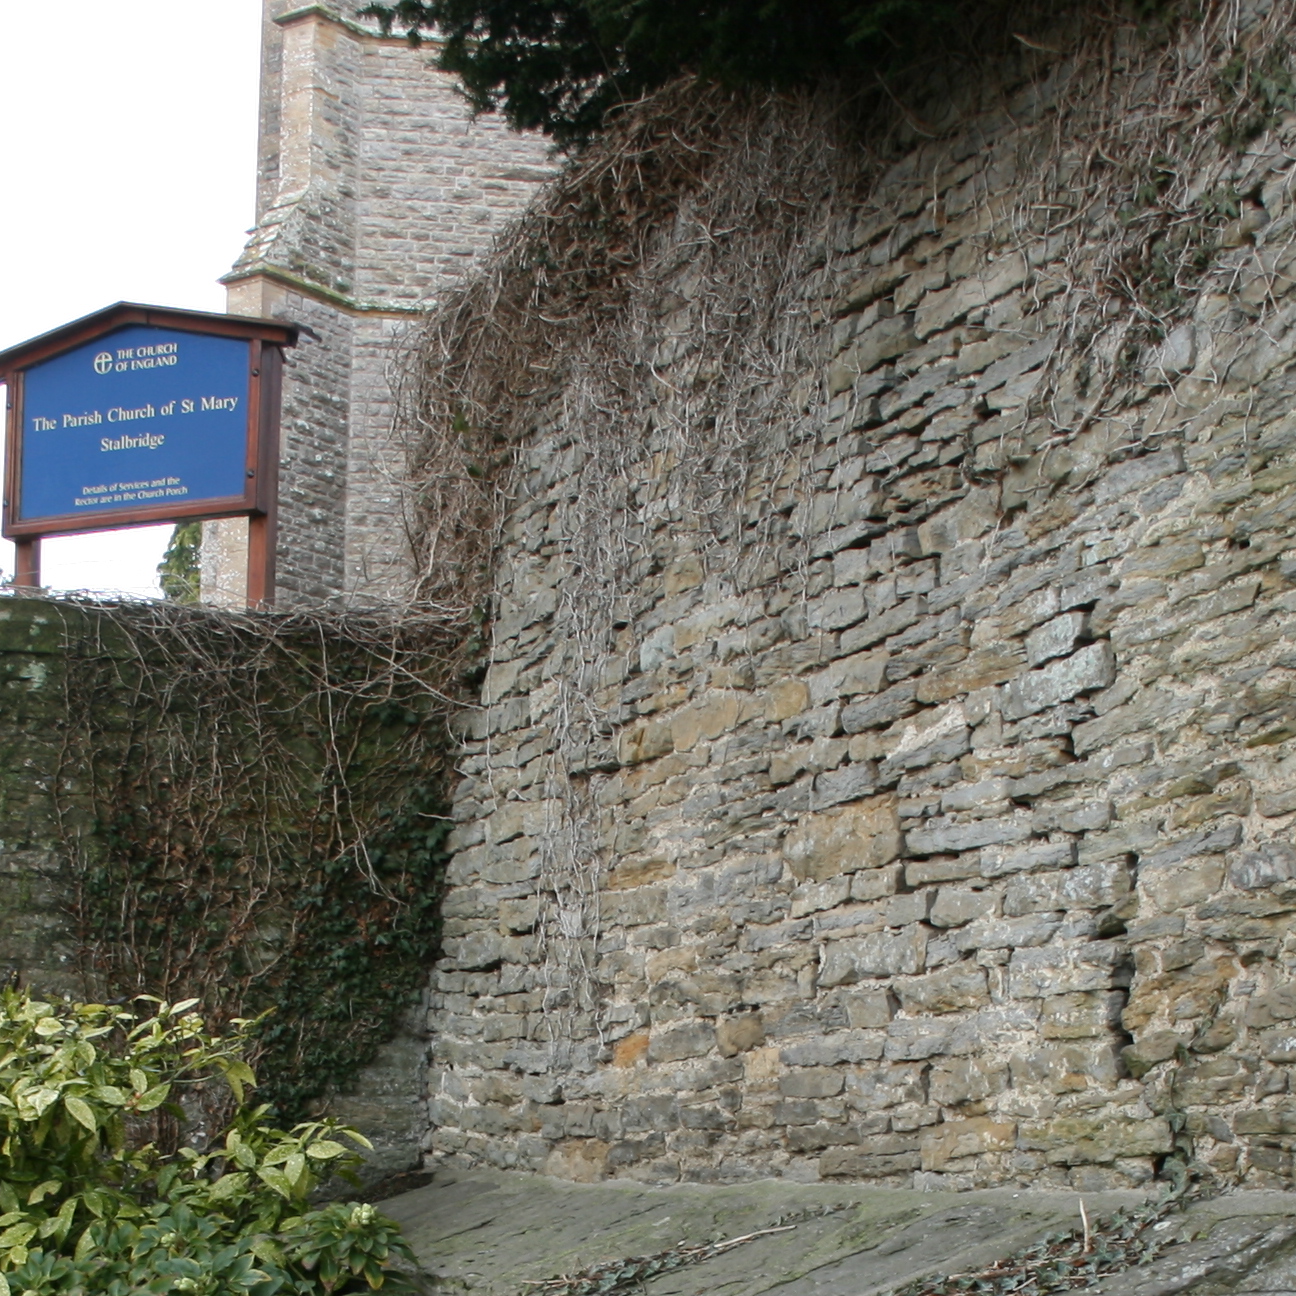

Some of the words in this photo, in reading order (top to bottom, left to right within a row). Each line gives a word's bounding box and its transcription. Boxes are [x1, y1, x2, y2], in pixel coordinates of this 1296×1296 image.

[116, 348, 134, 359] THE
[136, 343, 178, 358] CHURCH
[115, 361, 128, 372] OF
[131, 355, 177, 371] ENGLAND
[32, 417, 57, 432] The
[63, 410, 102, 428] Parish
[107, 404, 155, 422] Church
[160, 400, 176, 416] of
[181, 399, 194, 414] St
[200, 396, 238, 412] Mary
[100, 432, 165, 452] Stalbridge
[82, 484, 108, 495] Details
[109, 483, 118, 492] of
[118, 481, 149, 491] Services
[150, 478, 166, 487] and
[167, 476, 181, 485] the
[74, 497, 99, 506] Rector
[99, 495, 113, 503] are
[113, 493, 122, 501] in
[123, 492, 137, 501] the
[137, 488, 164, 500] Church
[165, 486, 189, 497] Porch
